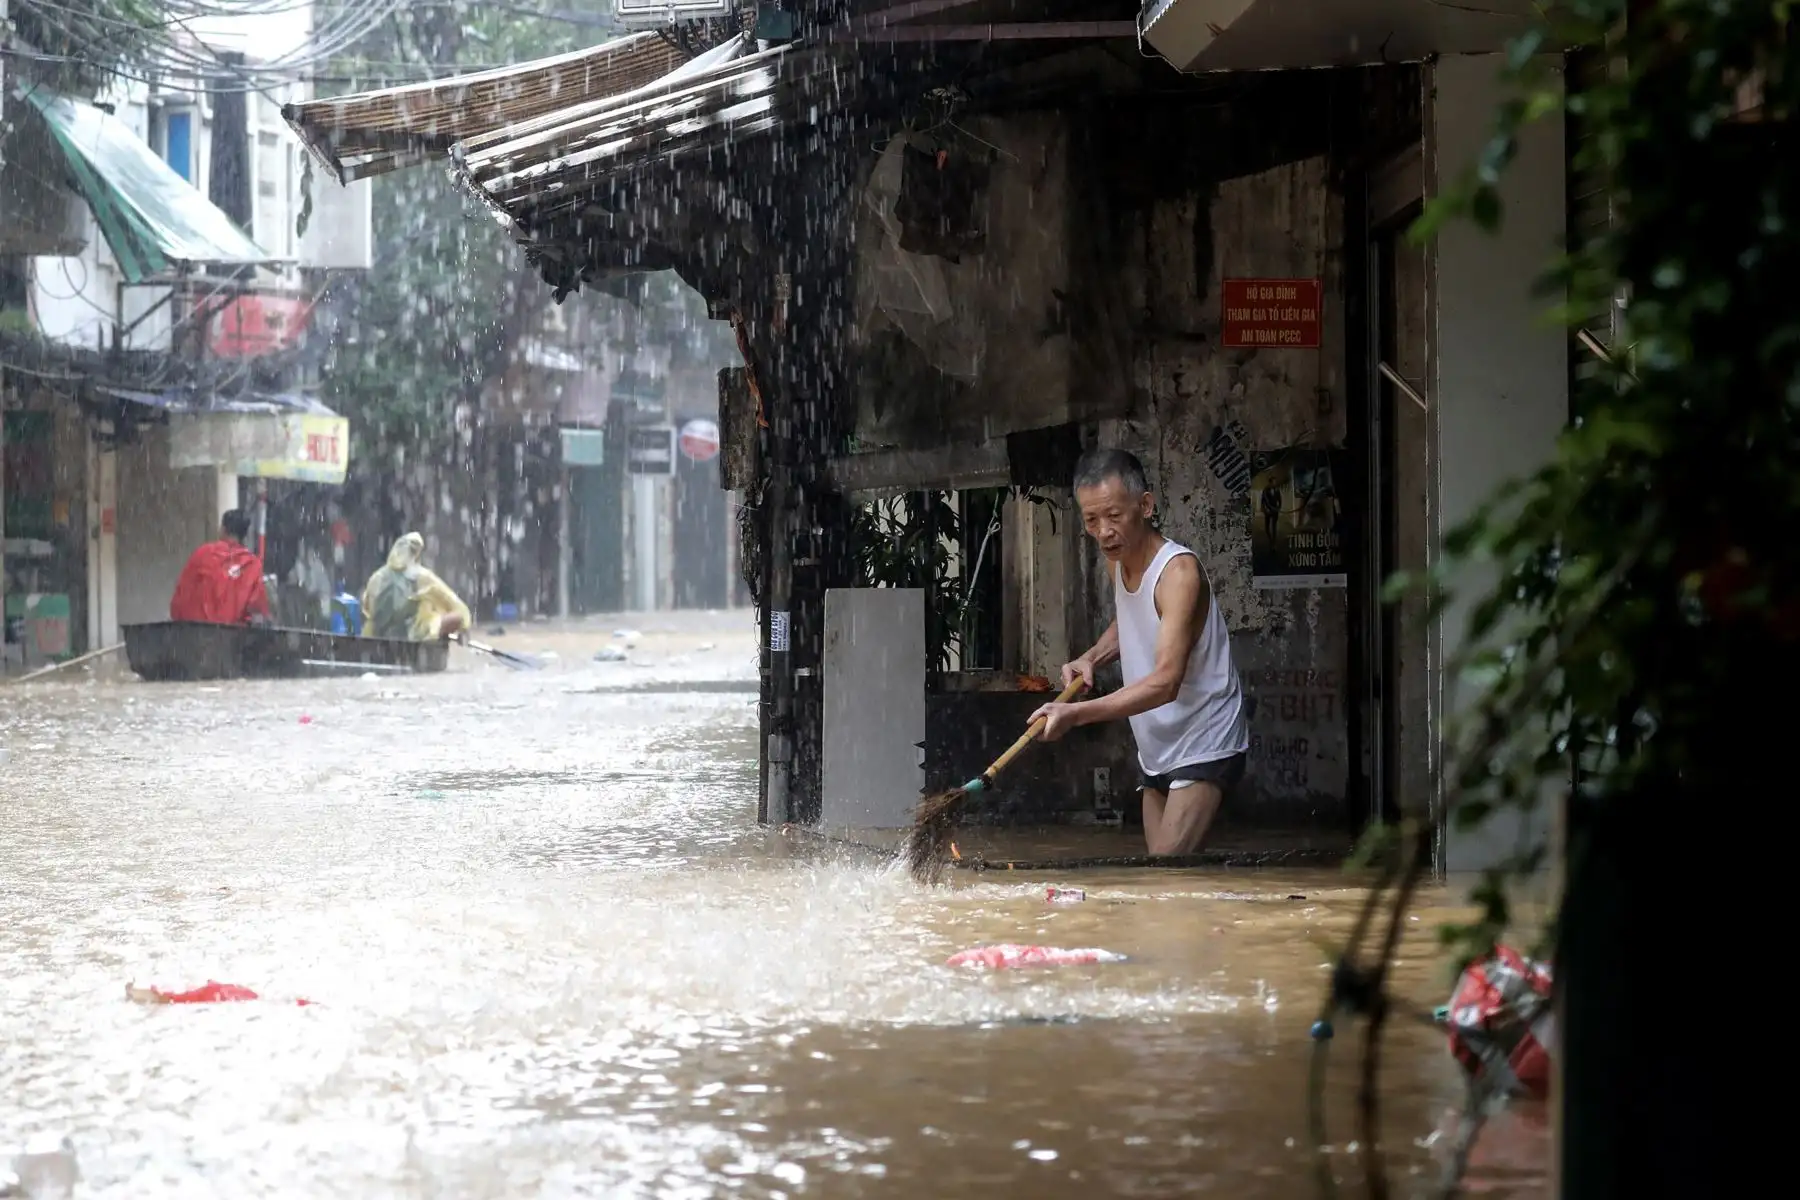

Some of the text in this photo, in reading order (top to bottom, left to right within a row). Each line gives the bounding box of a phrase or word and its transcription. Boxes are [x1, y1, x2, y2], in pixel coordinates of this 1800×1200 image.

[1260, 287, 1274, 300] GIA
[1227, 308, 1251, 321] THAM
[1253, 308, 1267, 321] GIA
[1302, 308, 1316, 321] GIA
[1241, 329, 1254, 343] AN
[1279, 329, 1302, 343] PCCC
